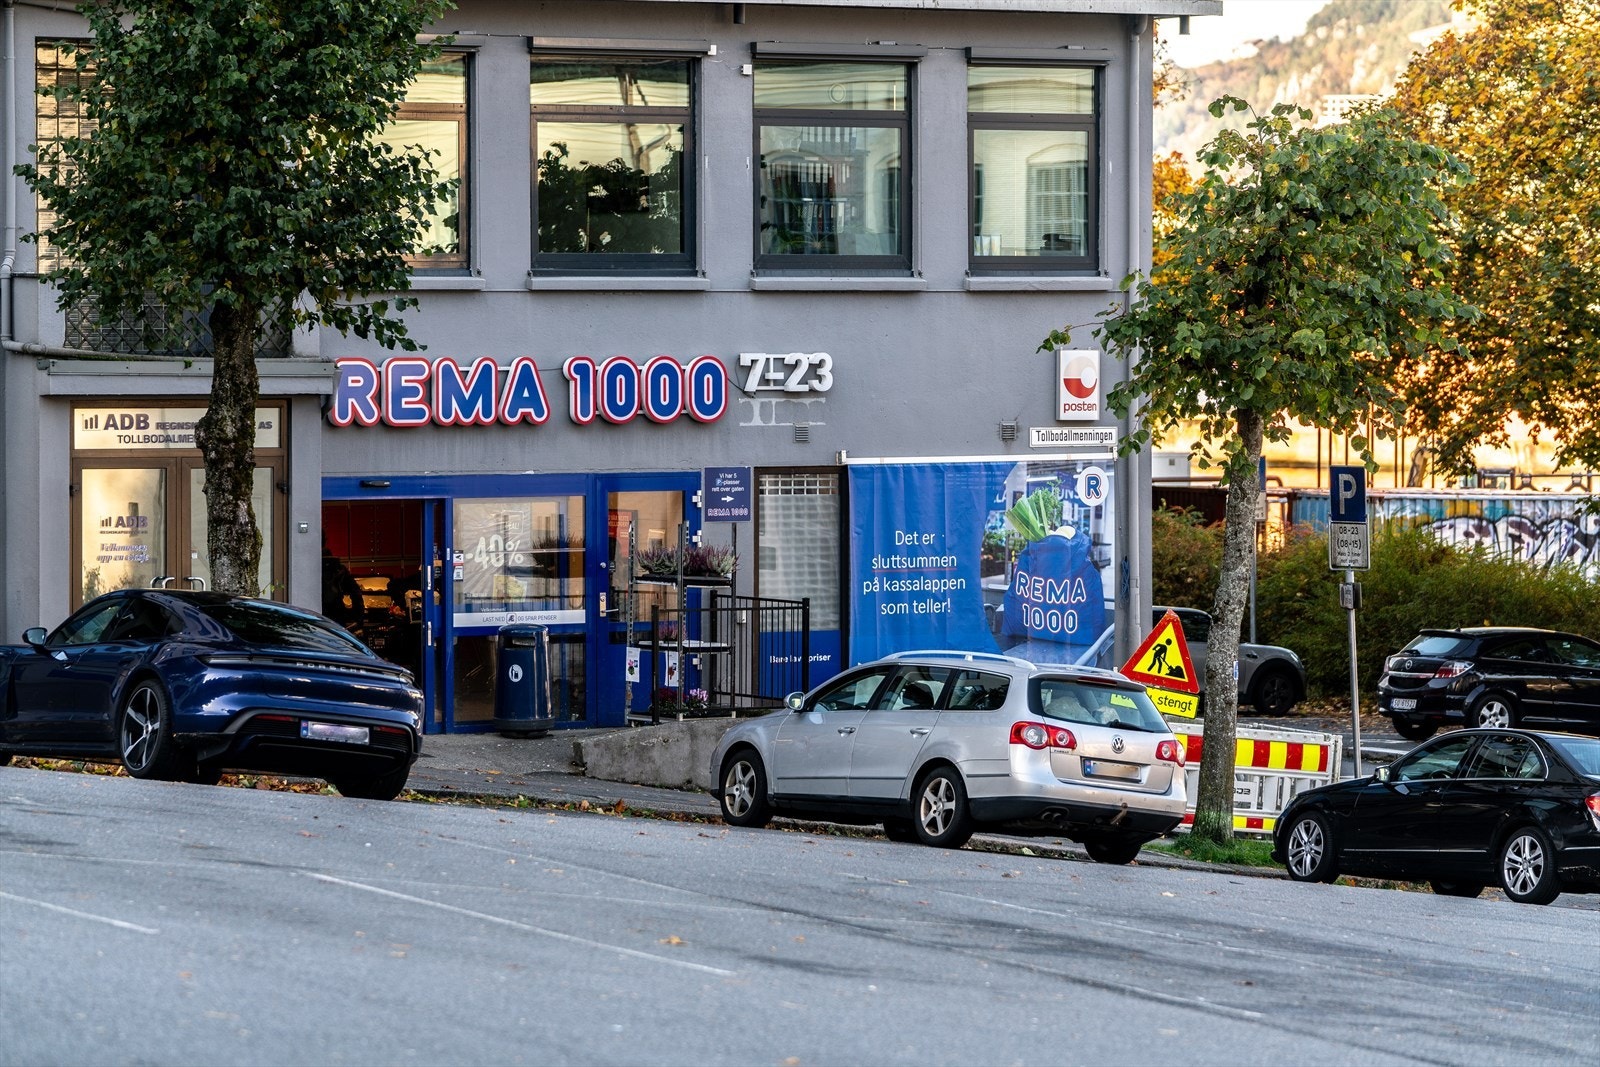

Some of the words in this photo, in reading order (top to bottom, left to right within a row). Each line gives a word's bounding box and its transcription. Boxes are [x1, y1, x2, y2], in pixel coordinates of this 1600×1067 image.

[739, 352, 833, 392] 7-23
[328, 356, 551, 427] REMA
[563, 355, 729, 425] 1000
[1063, 401, 1097, 413] posten
[103, 413, 150, 431] ADB
[258, 421, 273, 429] AS
[117, 434, 197, 444] TOLLBODALME
[1036, 429, 1113, 443] Tollbodallmenningen
[1085, 473, 1102, 500] R
[1338, 473, 1357, 515] P
[708, 508, 730, 516] REMA
[731, 507, 748, 516] 1000
[114, 515, 148, 528] ADB
[895, 530, 919, 546] Det
[922, 533, 936, 545] er
[1339, 526, 1359, 535] 08-23
[1336, 539, 1361, 549] (08-15)
[872, 554, 957, 569] sluttsummen
[863, 576, 880, 595] på
[883, 576, 966, 593] kassalappen
[1015, 571, 1087, 604] REMA
[881, 603, 909, 615] som
[913, 597, 951, 614] teller!
[1022, 603, 1078, 634] 1000
[808, 653, 832, 663] priser
[296, 662, 367, 672] PORSCHE
[1157, 695, 1193, 713] stengt
